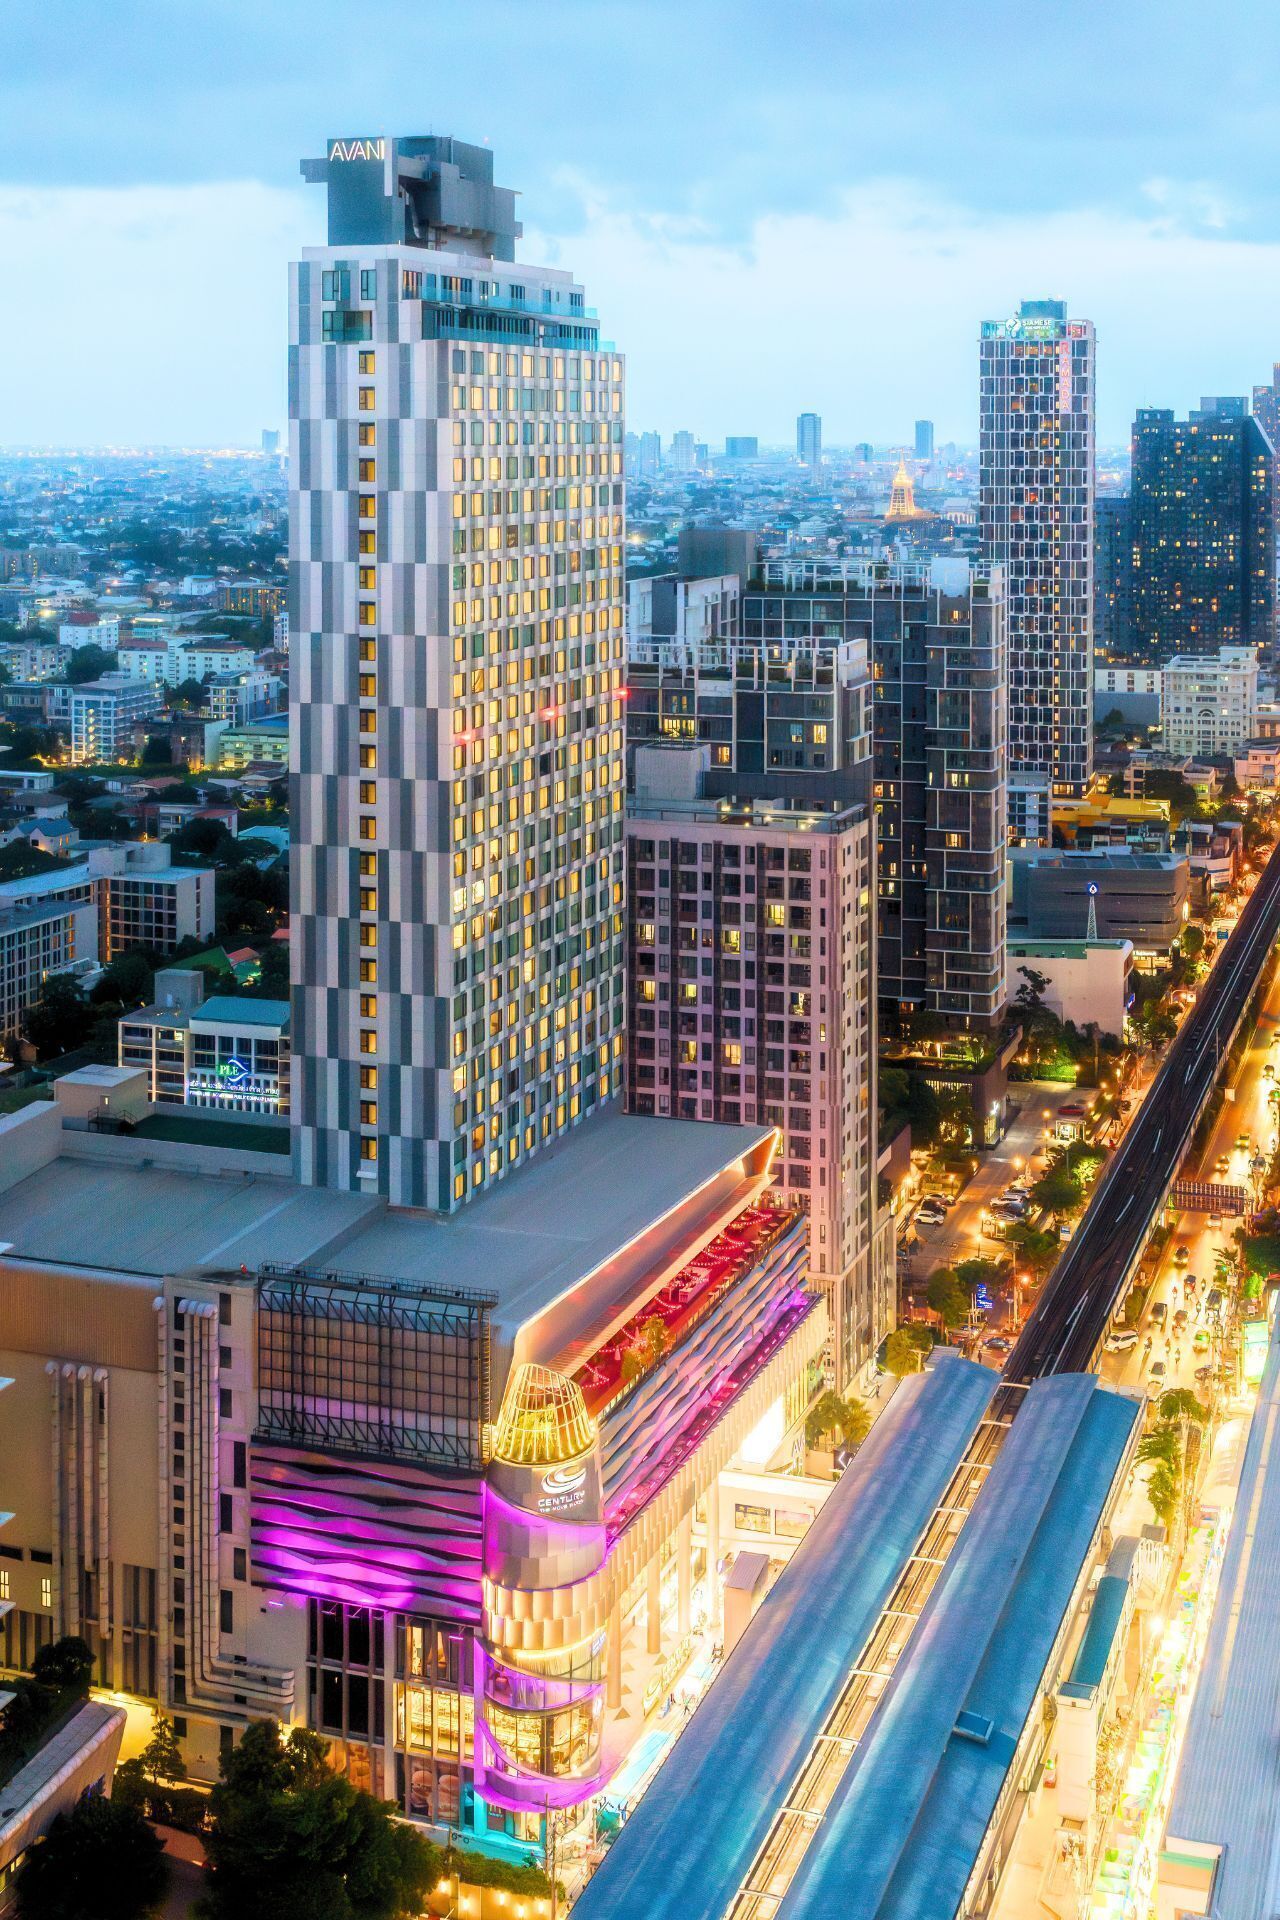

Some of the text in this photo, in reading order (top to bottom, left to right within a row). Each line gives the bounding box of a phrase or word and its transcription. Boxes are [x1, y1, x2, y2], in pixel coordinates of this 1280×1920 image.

[330, 140, 384, 161] AVANI
[1060, 342, 1070, 409] RAMADA
[220, 1065, 239, 1075] PLE
[538, 1490, 585, 1507] CENTURY
